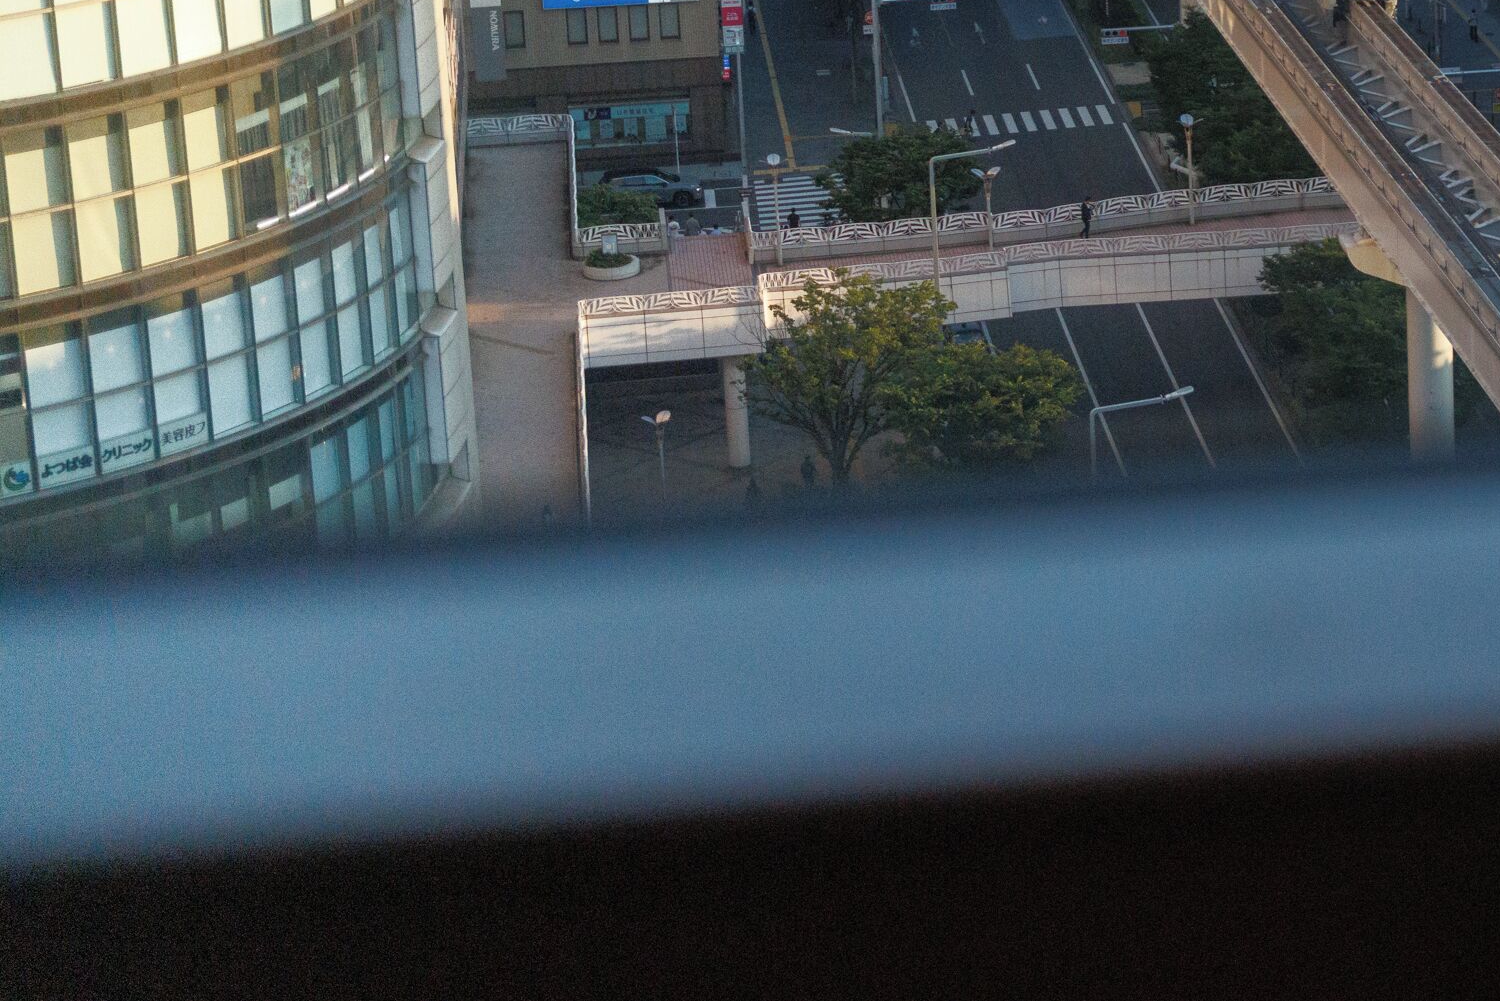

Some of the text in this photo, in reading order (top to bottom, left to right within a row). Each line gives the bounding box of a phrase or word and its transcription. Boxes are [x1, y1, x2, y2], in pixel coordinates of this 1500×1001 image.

[489, 10, 500, 51] NOMURA
[41, 454, 93, 478] よつば会
[101, 438, 153, 463] クリニック
